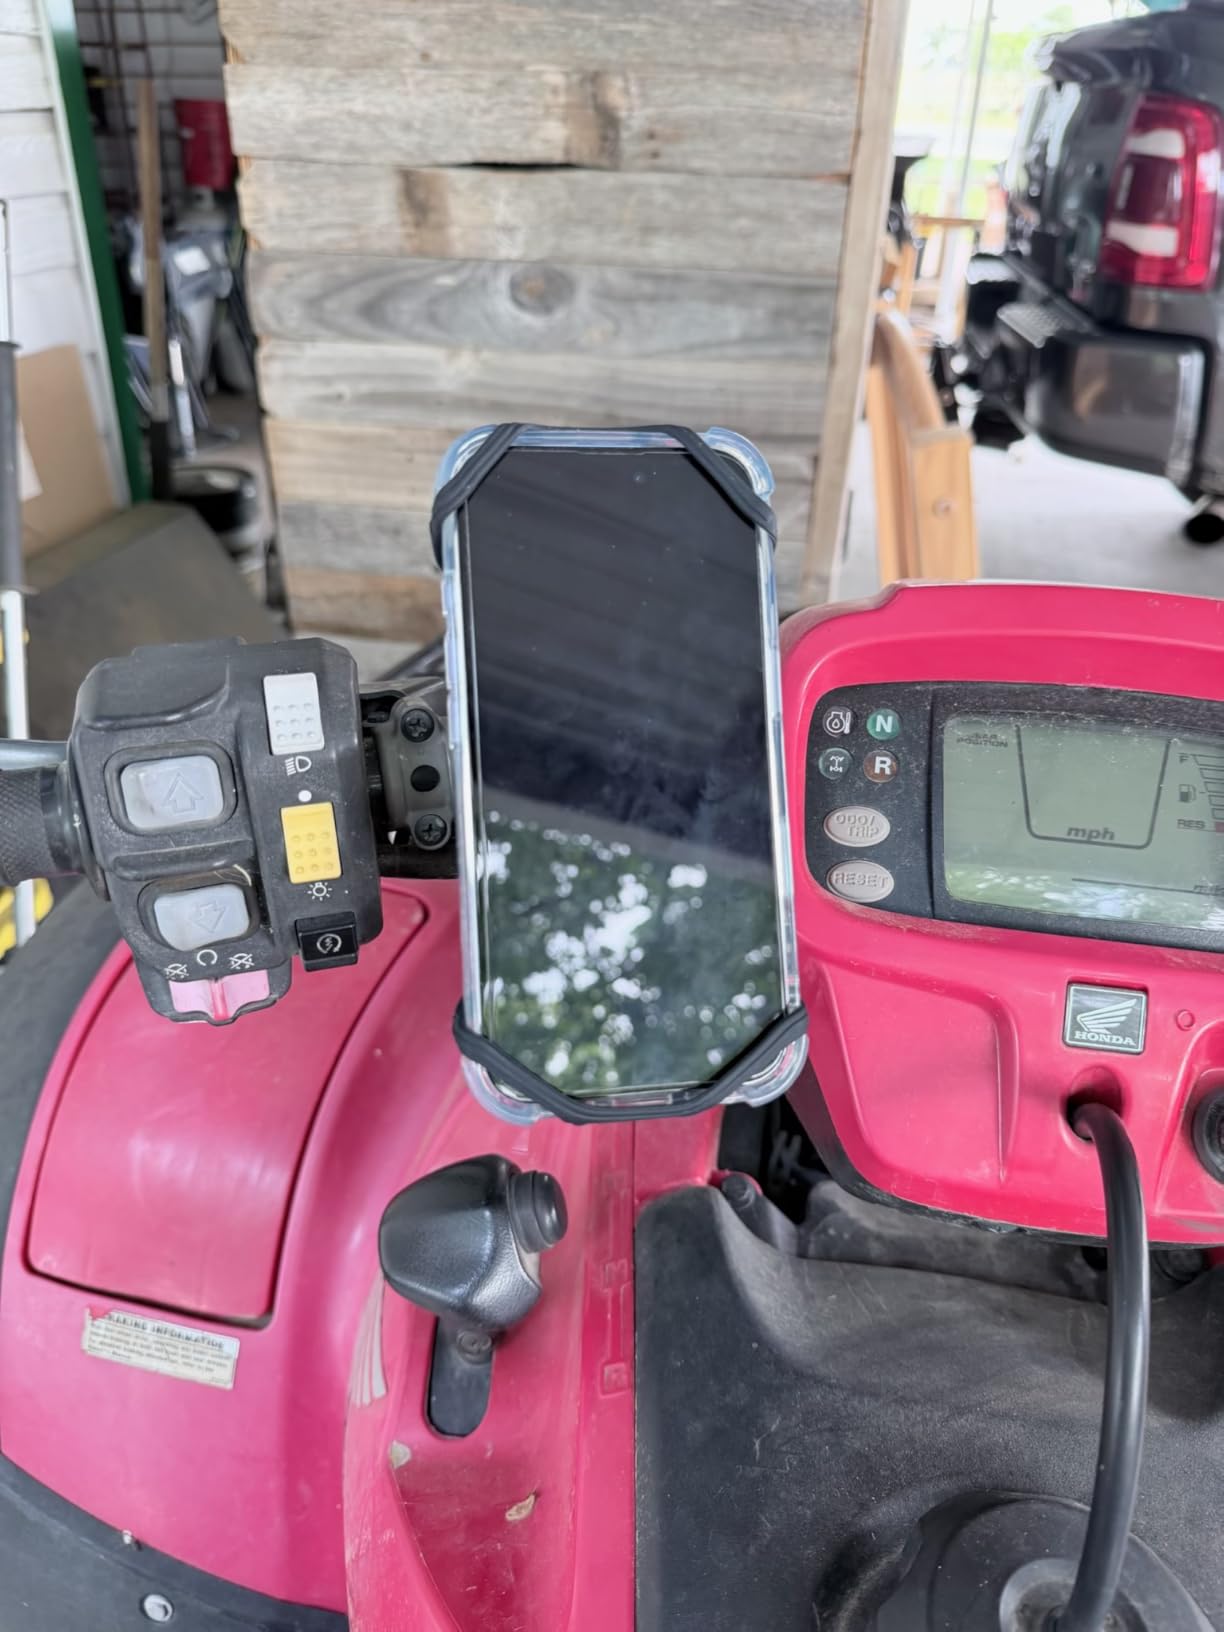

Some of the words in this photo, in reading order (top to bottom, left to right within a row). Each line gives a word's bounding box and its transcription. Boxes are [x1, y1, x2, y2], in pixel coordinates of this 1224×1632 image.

[875, 714, 893, 733] N
[956, 737, 1009, 748] POSITION
[874, 756, 892, 775] R
[848, 825, 880, 838] TRIP
[1177, 819, 1206, 831] RES
[1066, 827, 1115, 842] mph
[834, 872, 889, 889] RESET
[1074, 1031, 1137, 1046] HONDA
